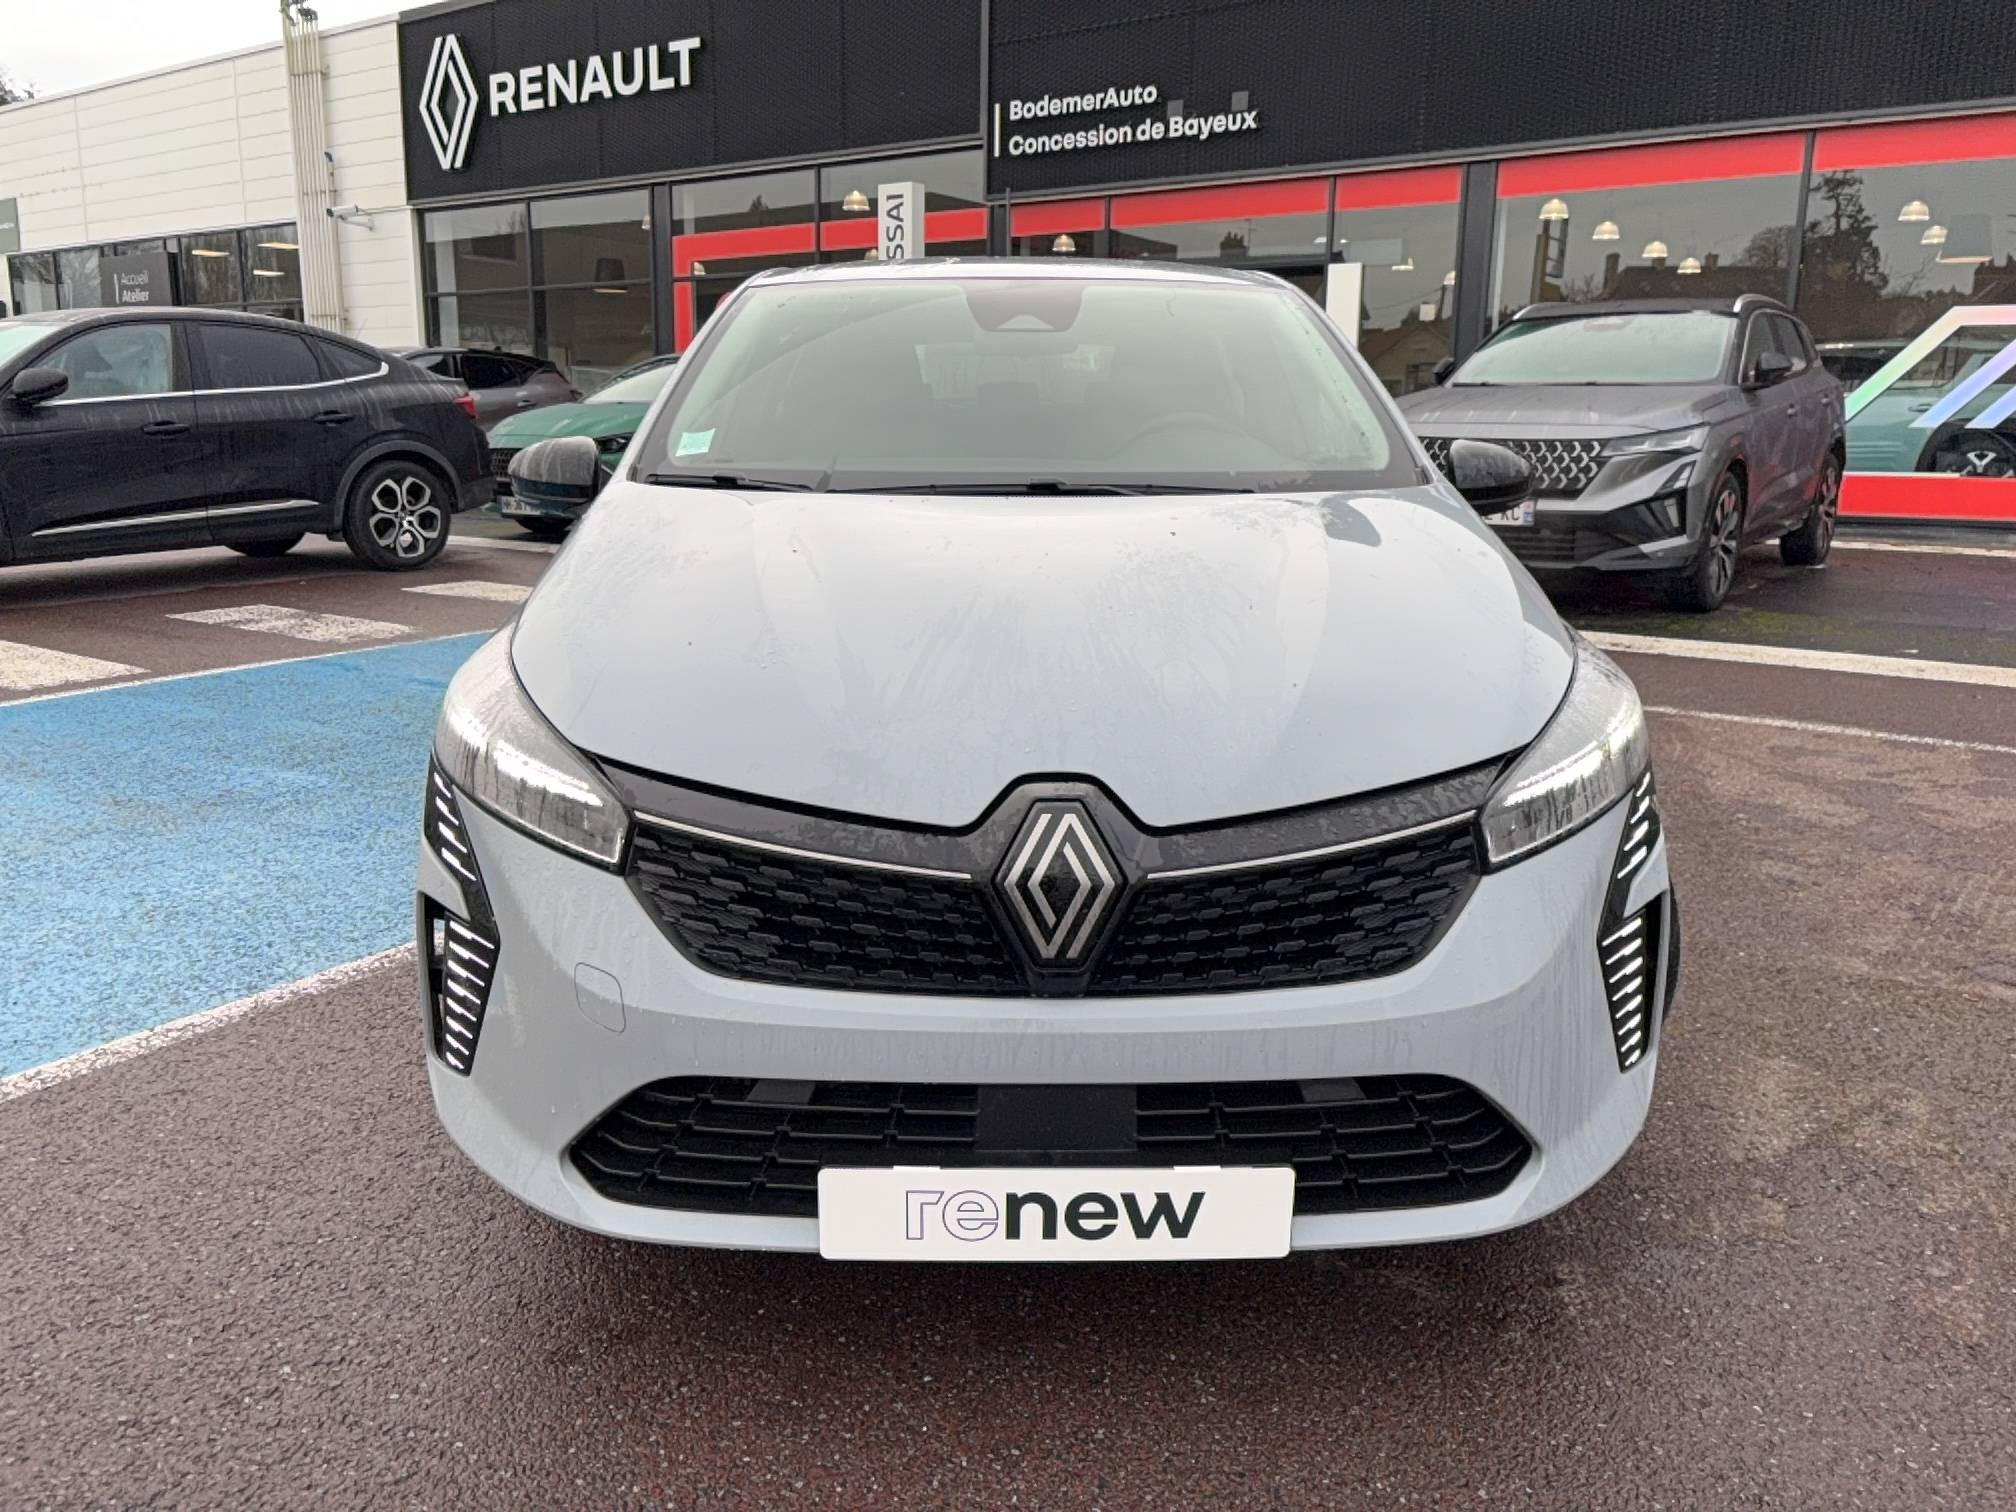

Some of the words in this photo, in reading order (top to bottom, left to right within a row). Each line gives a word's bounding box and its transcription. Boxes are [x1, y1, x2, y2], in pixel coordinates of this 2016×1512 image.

[489, 36, 700, 117] RENAULT
[1008, 85, 1158, 121] BodemerAuto
[1008, 124, 1131, 155] Concession
[1136, 118, 1165, 140] de
[1169, 110, 1257, 140] Bayeux
[120, 270, 149, 285] Accueil
[121, 288, 149, 303] Atelier
[905, 1189, 1206, 1242] renew
